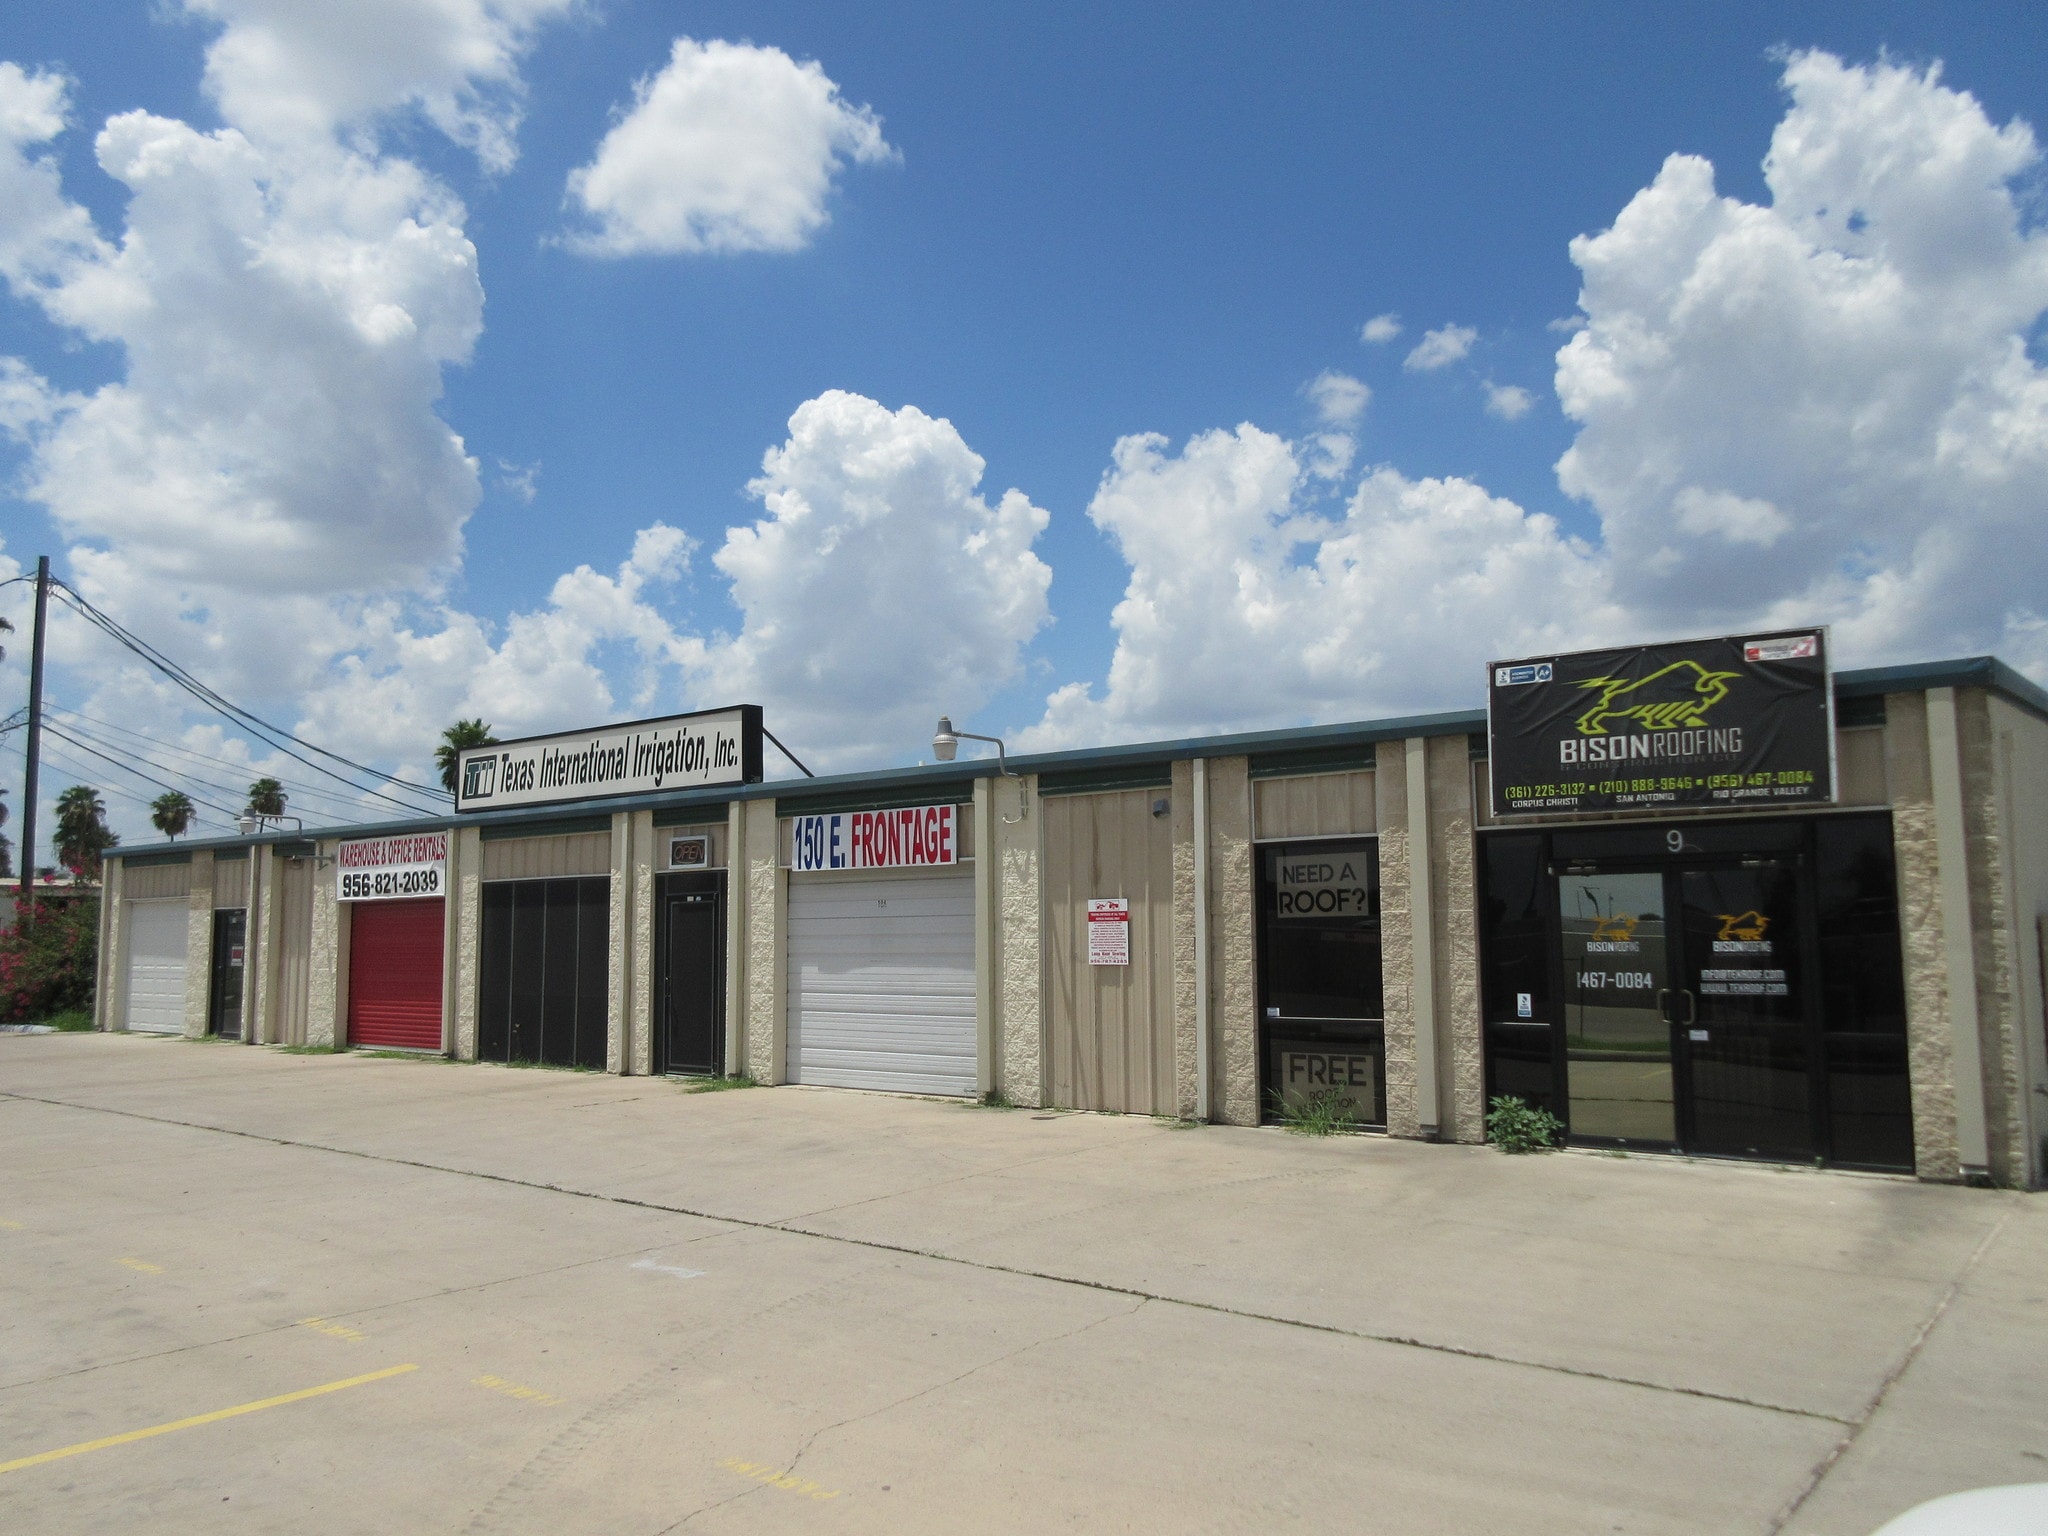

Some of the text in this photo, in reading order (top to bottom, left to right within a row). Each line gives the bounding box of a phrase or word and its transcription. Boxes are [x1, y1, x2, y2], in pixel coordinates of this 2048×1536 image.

[499, 752, 535, 793] Texas
[539, 735, 631, 789] International
[633, 727, 710, 787] Irrigation,
[714, 731, 738, 768] Inc.
[1504, 770, 1815, 799] (361) 226-3132 (210) 888-9646 (956) 467-0084
[1616, 792, 1675, 803] SAN ANTONIO
[1712, 786, 1810, 798] RIO GRANDE VALLEY
[1512, 797, 1578, 808] CORPUS CHRISTI
[340, 835, 446, 867] WAREHOUSE & OFFICE RENTALS
[795, 806, 952, 870] 150 E. FRONTAGE
[1666, 830, 1683, 852] 9
[674, 845, 704, 860] OPEN
[343, 870, 438, 897] 956-821-2039
[1282, 862, 1357, 884] NEED A
[1278, 888, 1367, 914] ROOF?
[1289, 1053, 1367, 1086] FREE
